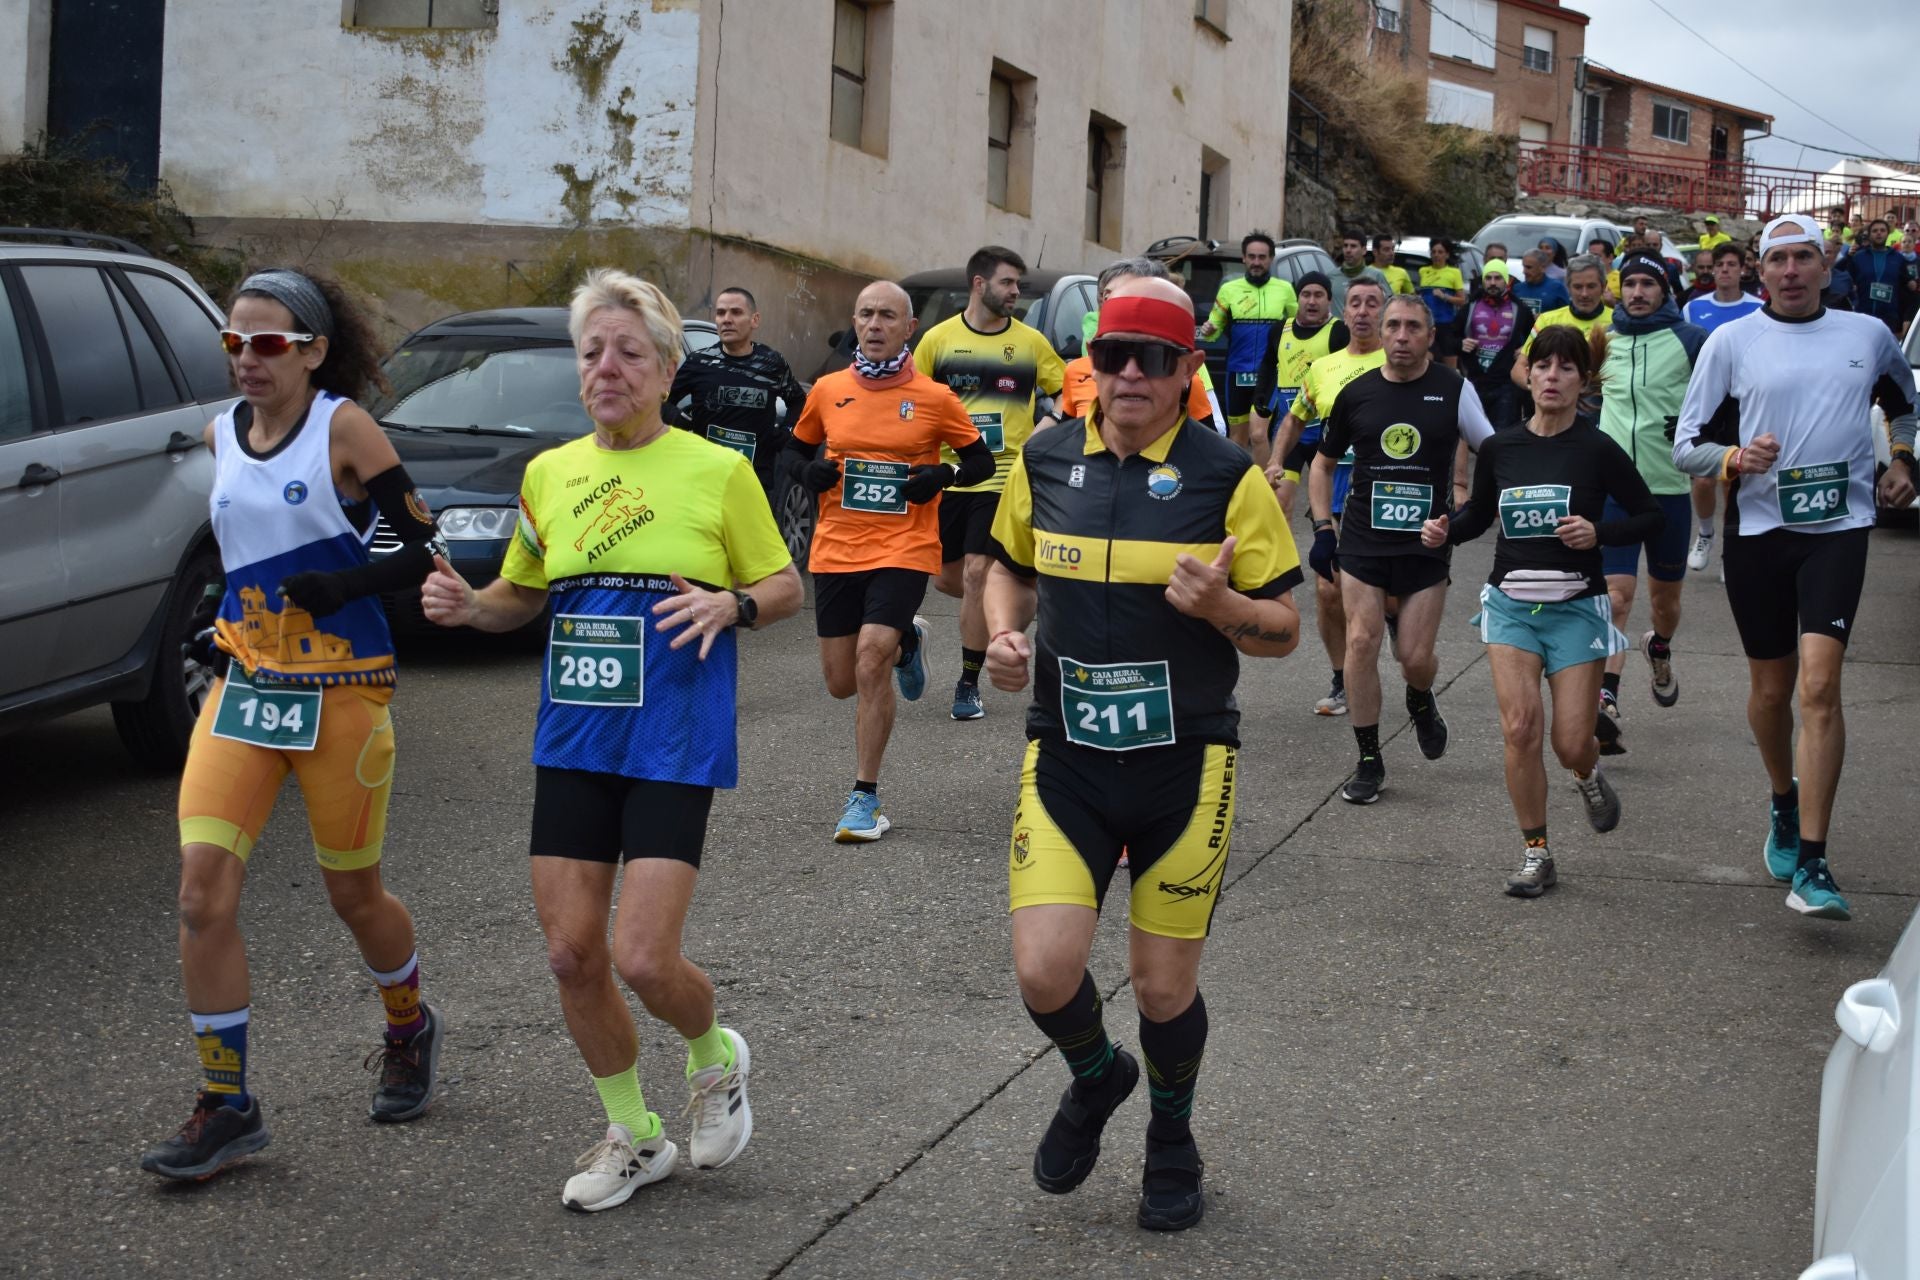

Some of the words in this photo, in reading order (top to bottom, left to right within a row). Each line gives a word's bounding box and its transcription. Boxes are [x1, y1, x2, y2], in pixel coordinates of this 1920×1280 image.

[566, 474, 590, 488] GOBIK
[572, 474, 622, 518] RINCON
[853, 482, 897, 503] 252
[1791, 488, 1840, 514] 249
[1381, 503, 1422, 522] 202
[1511, 507, 1560, 529] 284
[587, 509, 656, 564] ATLETISMO
[1040, 538, 1082, 563] Virto
[581, 577, 597, 587] DE
[647, 578, 681, 592] RIOJA
[585, 630, 621, 638] NAVARRA
[592, 622, 617, 631] RURAL
[560, 655, 623, 689] 289
[1092, 671, 1112, 679] CAJA
[1112, 669, 1141, 677] RURAL
[1105, 675, 1146, 685] NAVARRA
[239, 697, 303, 733] 194
[1076, 700, 1148, 734] 211
[1207, 744, 1236, 849] RUNNERS
